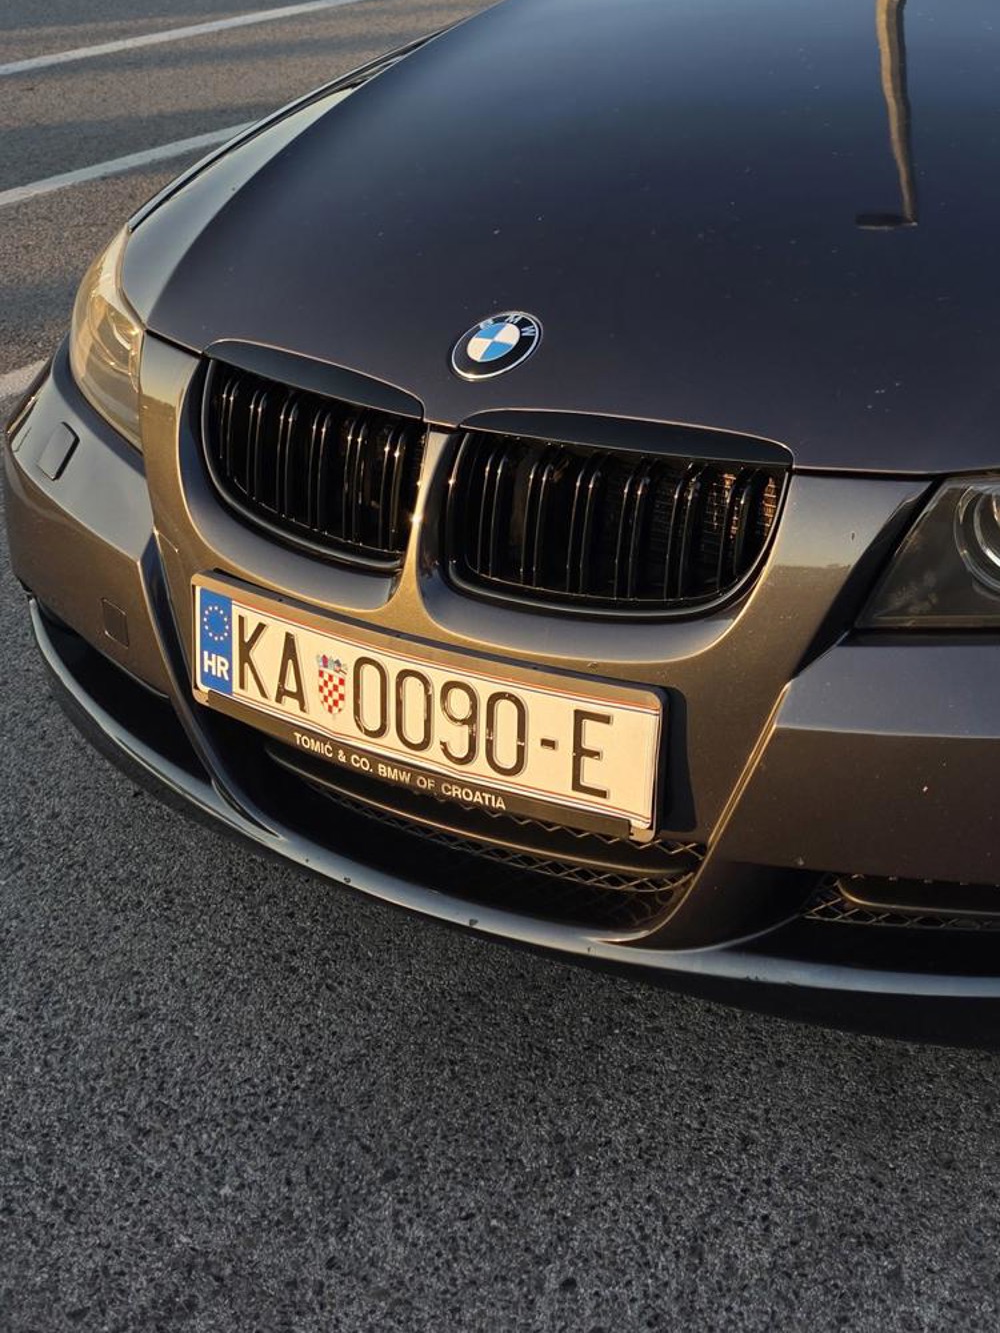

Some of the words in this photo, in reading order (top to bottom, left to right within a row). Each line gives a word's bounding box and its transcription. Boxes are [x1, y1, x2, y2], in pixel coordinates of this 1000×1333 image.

[480, 313, 536, 337] BMW
[203, 650, 230, 681] HR
[238, 614, 309, 714] KA
[293, 732, 333, 758] TOMIĆ
[337, 749, 347, 763] &
[351, 754, 374, 773] CO.
[378, 764, 412, 784] BMW
[416, 776, 436, 790] OF
[441, 783, 507, 810] CROATIA
